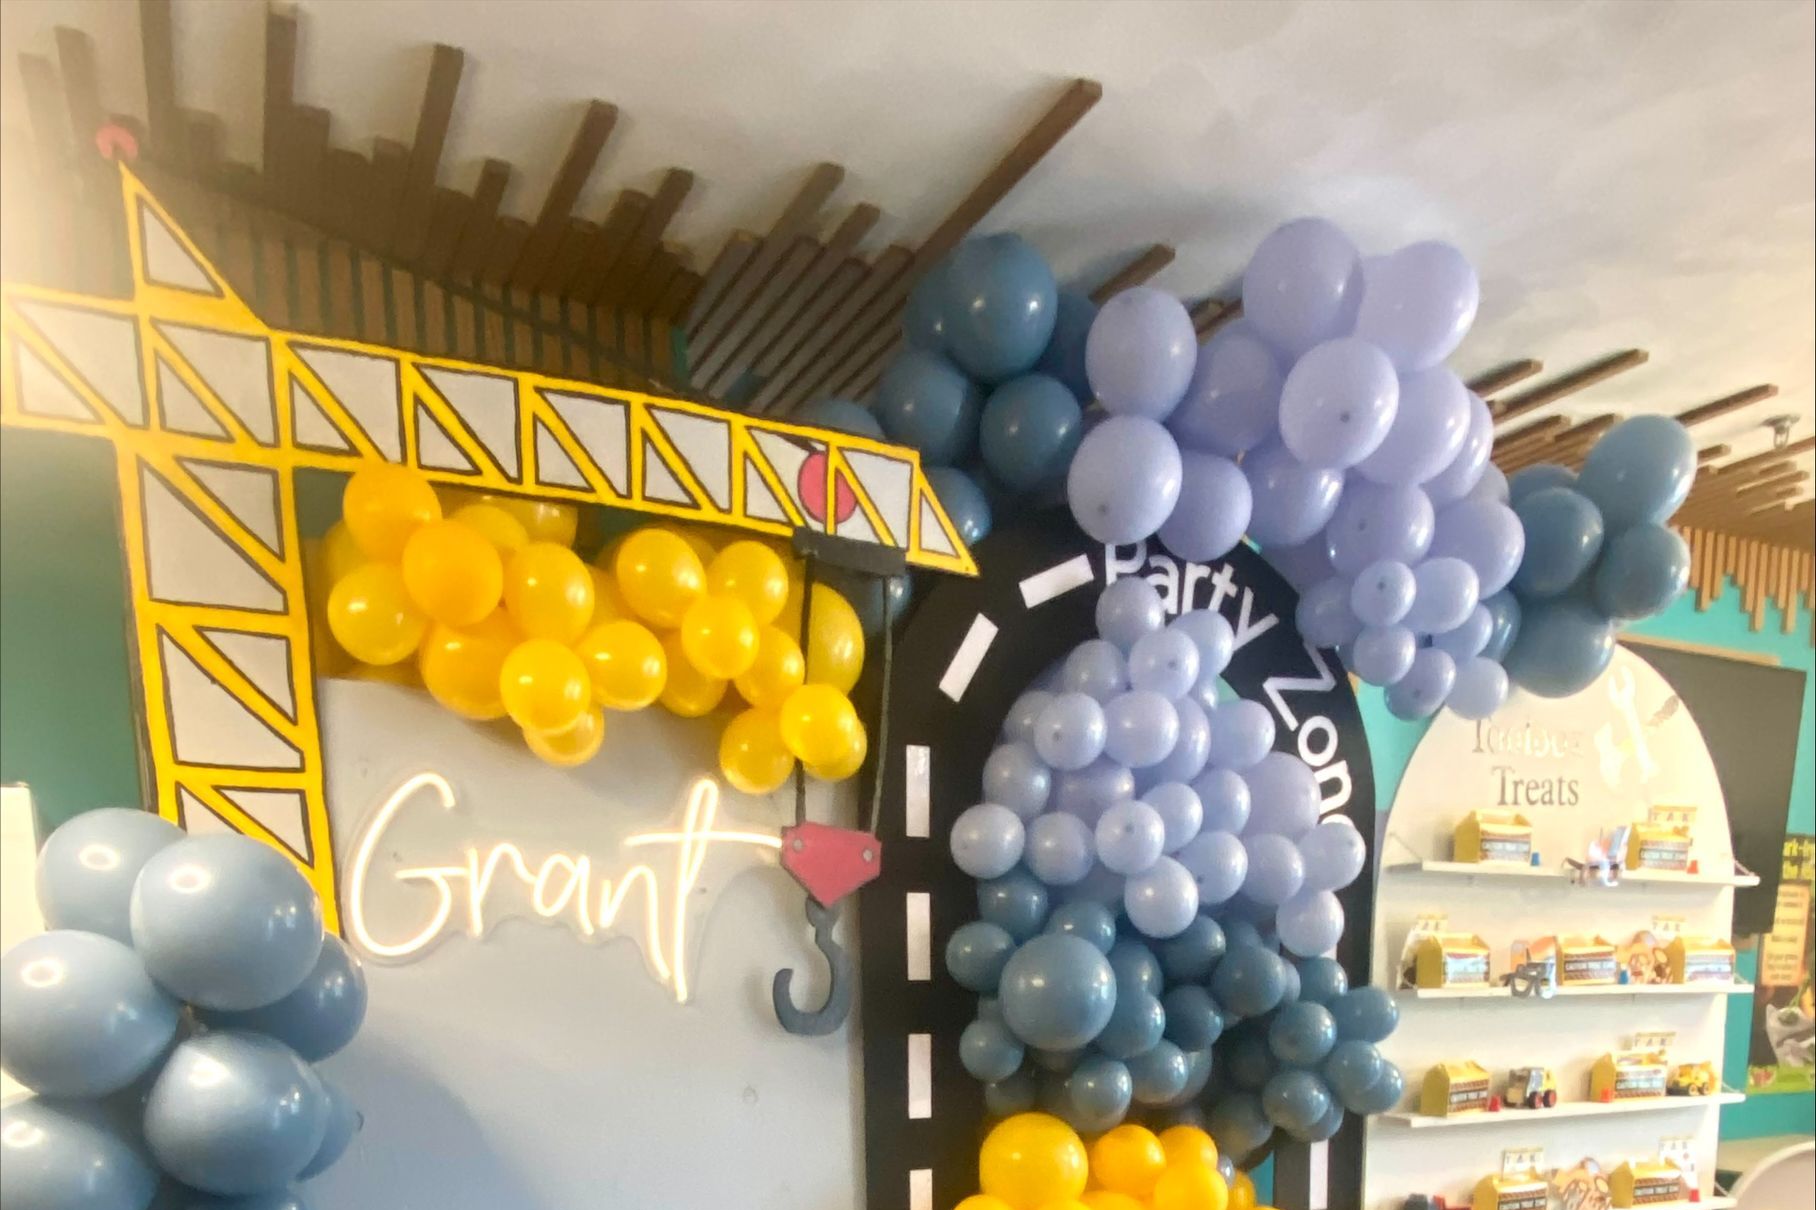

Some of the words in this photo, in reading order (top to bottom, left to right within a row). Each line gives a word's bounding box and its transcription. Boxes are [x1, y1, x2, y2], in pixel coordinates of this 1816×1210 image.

[1105, 543, 1279, 654] Party
[1263, 642, 1353, 826] Zon
[1491, 765, 1579, 806] Treats
[350, 772, 783, 1004] Grant
